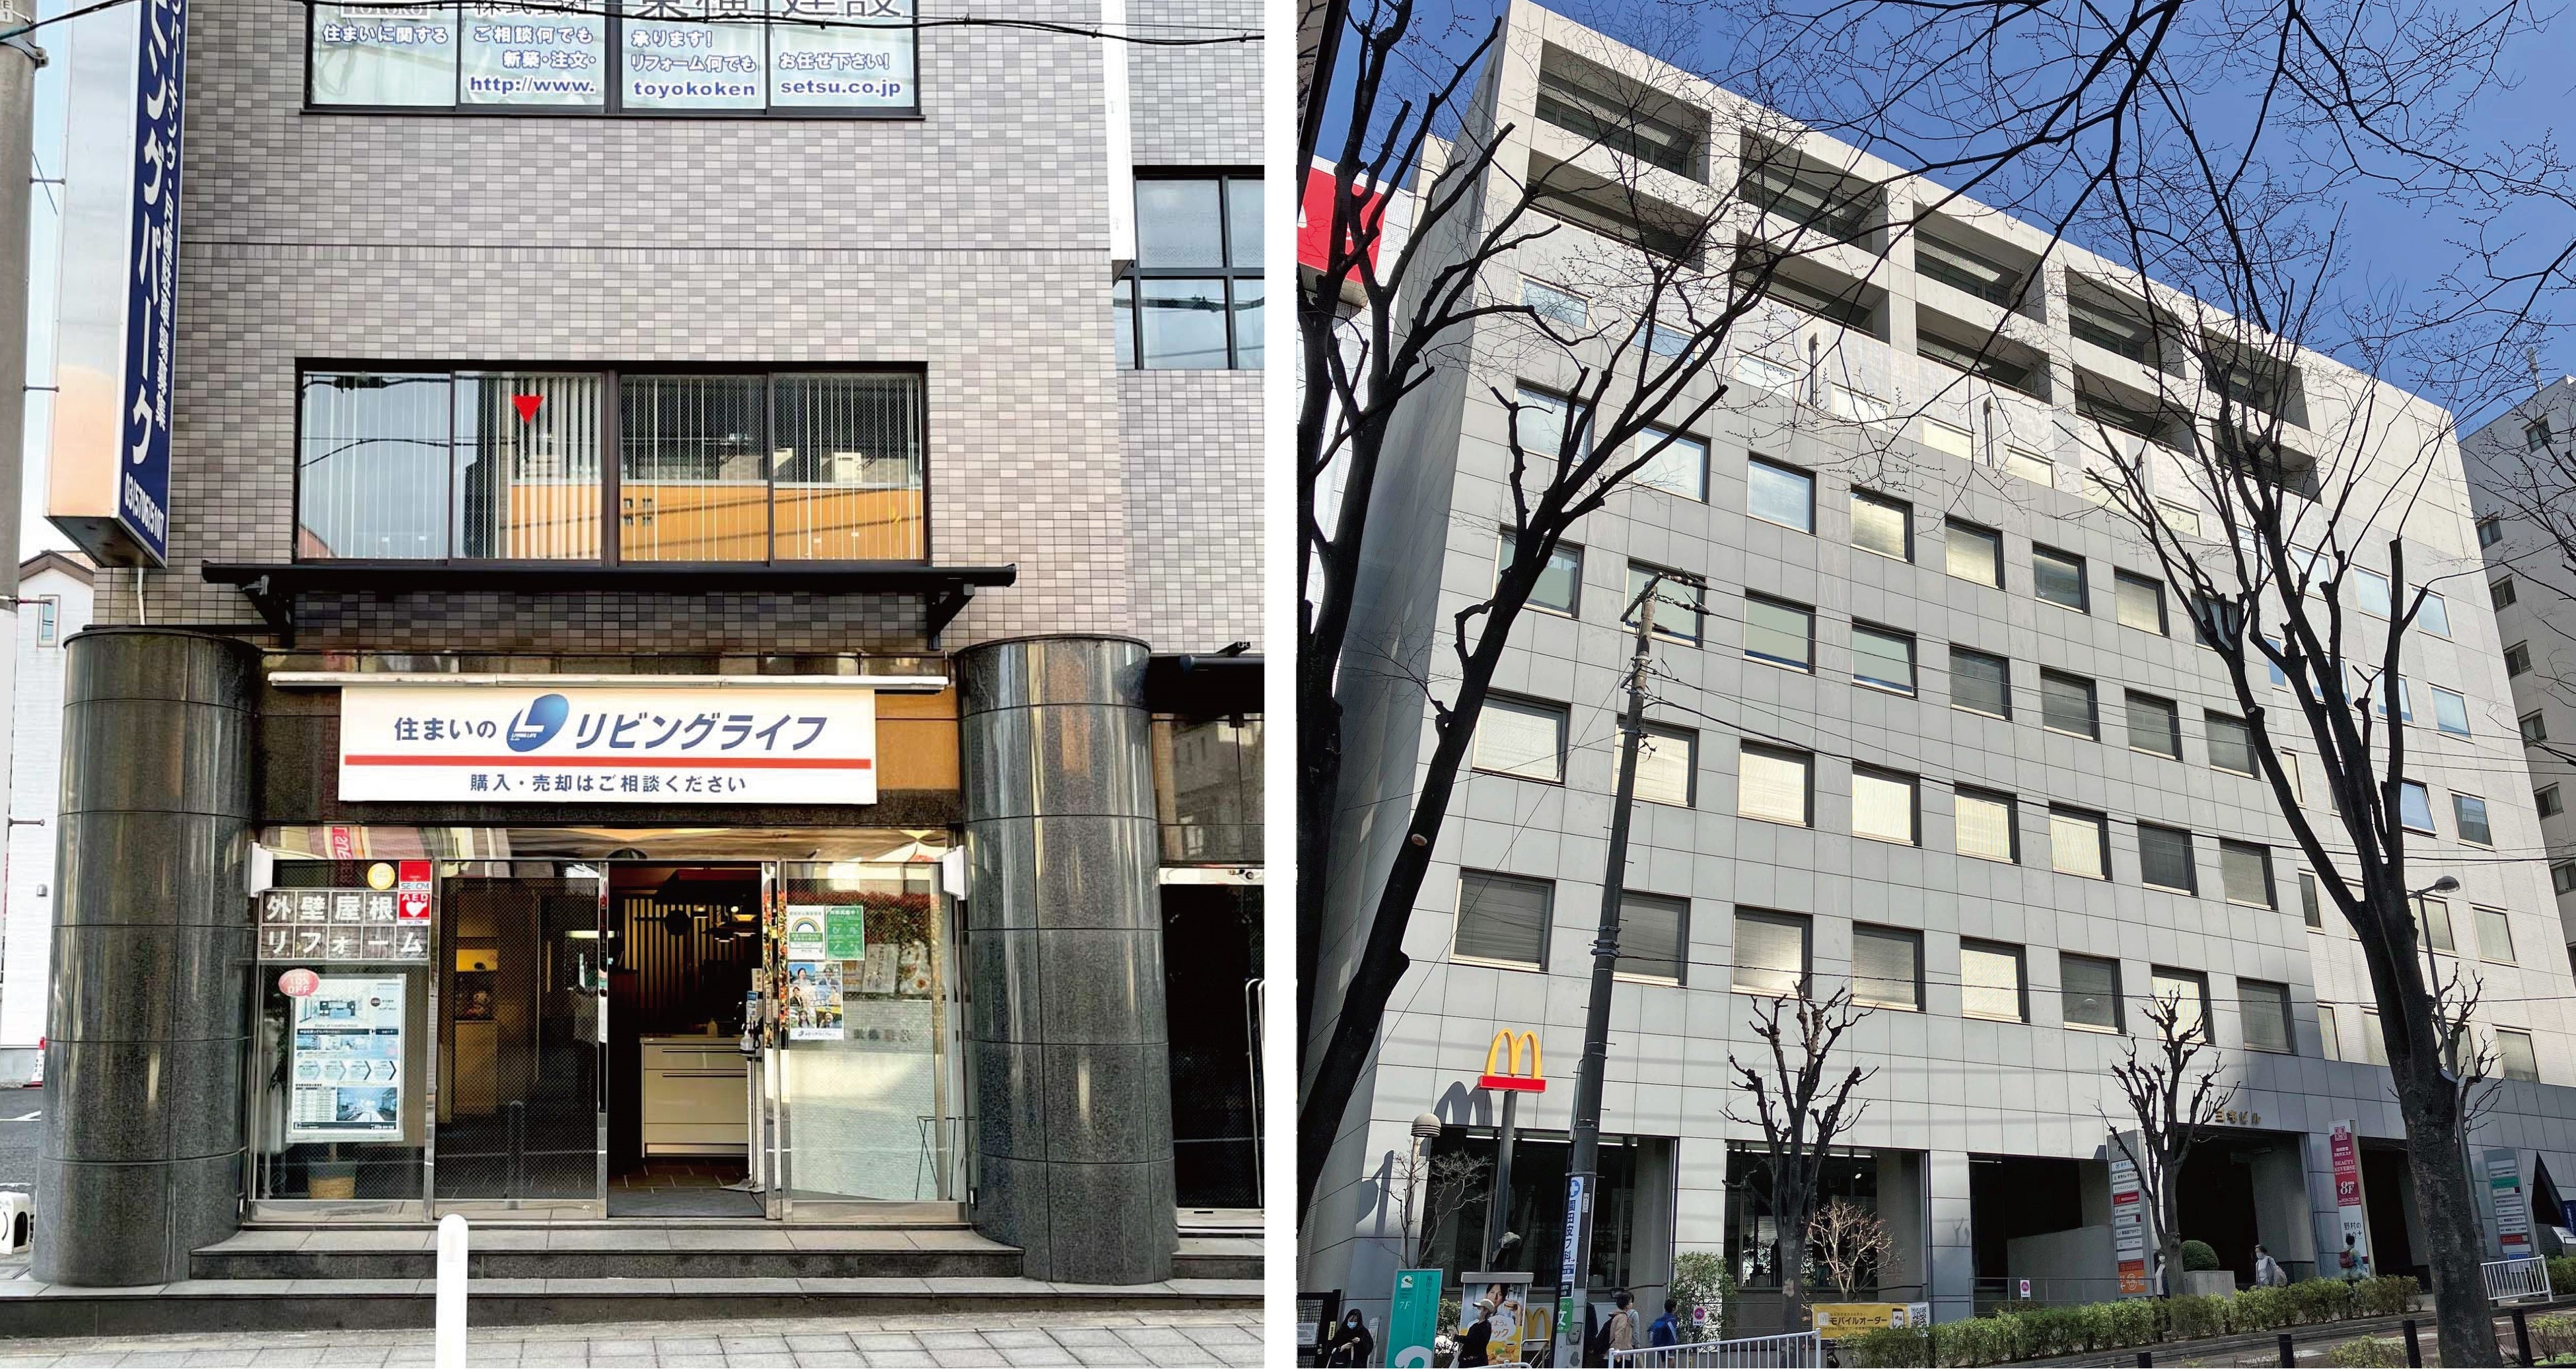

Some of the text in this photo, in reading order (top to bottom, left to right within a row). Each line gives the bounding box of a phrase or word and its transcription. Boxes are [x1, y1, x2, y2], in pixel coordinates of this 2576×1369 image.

[322, 26, 448, 43] 住まいに関する
[474, 26, 593, 44] ご相談何でも
[631, 55, 757, 73] リフォーム何でも
[470, 77, 901, 98] http://www. toyokoken setsu.co.jp
[394, 711, 828, 751] 住まいの リビングライフ
[470, 772, 746, 793] 購入・売却はご相談ください
[266, 894, 394, 921] 外壁屋根
[268, 930, 423, 954] リフォーム
[2340, 1181, 2354, 1195] 8F
[2343, 1222, 2361, 1230] 野村の
[1399, 1301, 1412, 1310] 7F
[1830, 1316, 1888, 1325] モバイルオーダー
